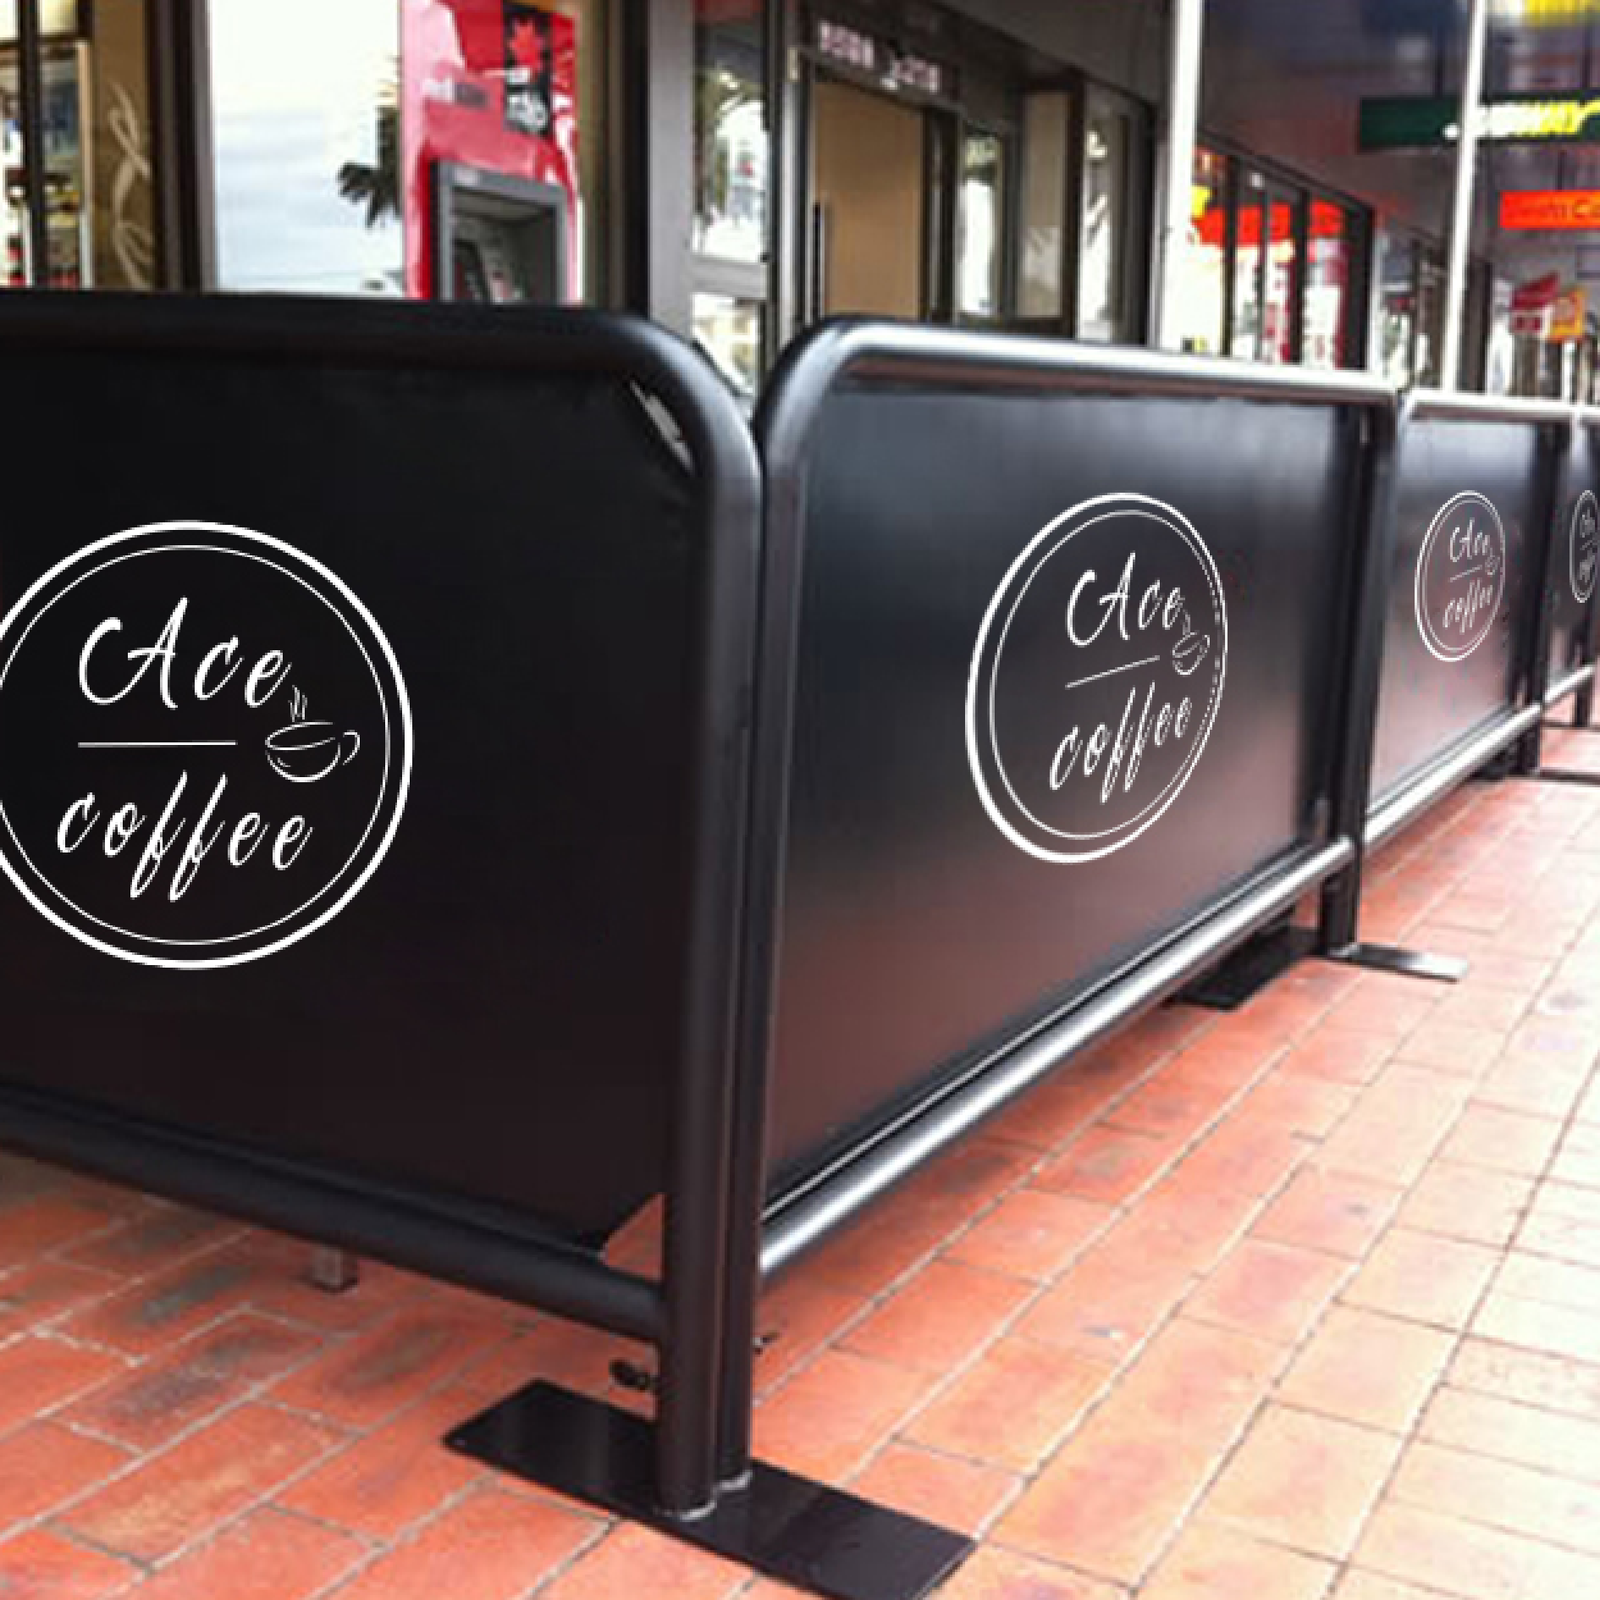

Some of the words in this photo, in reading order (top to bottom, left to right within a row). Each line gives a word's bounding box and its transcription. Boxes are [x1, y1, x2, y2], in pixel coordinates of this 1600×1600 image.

[79, 596, 291, 709] Ace
[1067, 552, 1182, 647] Ace
[1049, 681, 1191, 804] coffee
[57, 769, 313, 902] coffee
